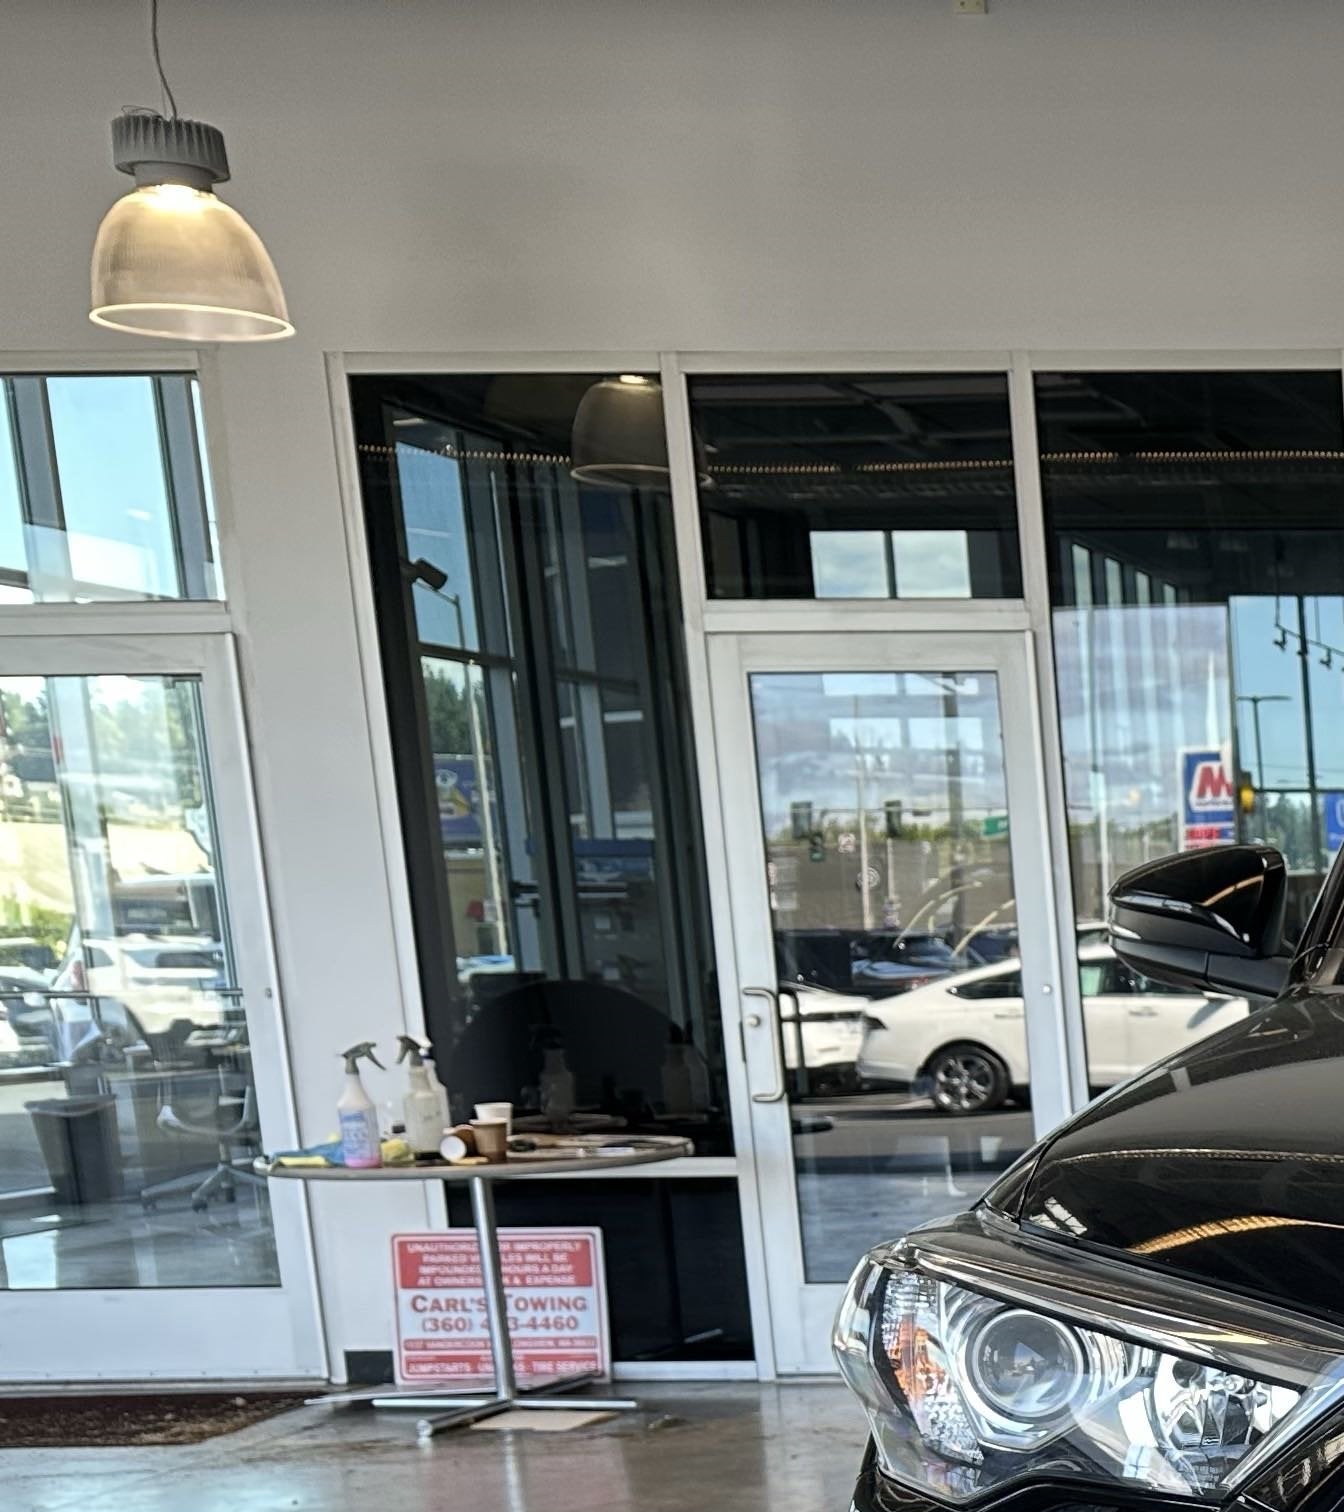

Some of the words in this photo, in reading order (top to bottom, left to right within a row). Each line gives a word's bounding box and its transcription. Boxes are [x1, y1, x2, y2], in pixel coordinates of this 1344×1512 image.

[525, 1253, 551, 1263] WILL
[553, 1253, 568, 1262] BE
[541, 1264, 550, 1273] A
[416, 1276, 432, 1286] AT
[505, 1294, 587, 1312] OWING
[421, 1315, 473, 1332] (360)
